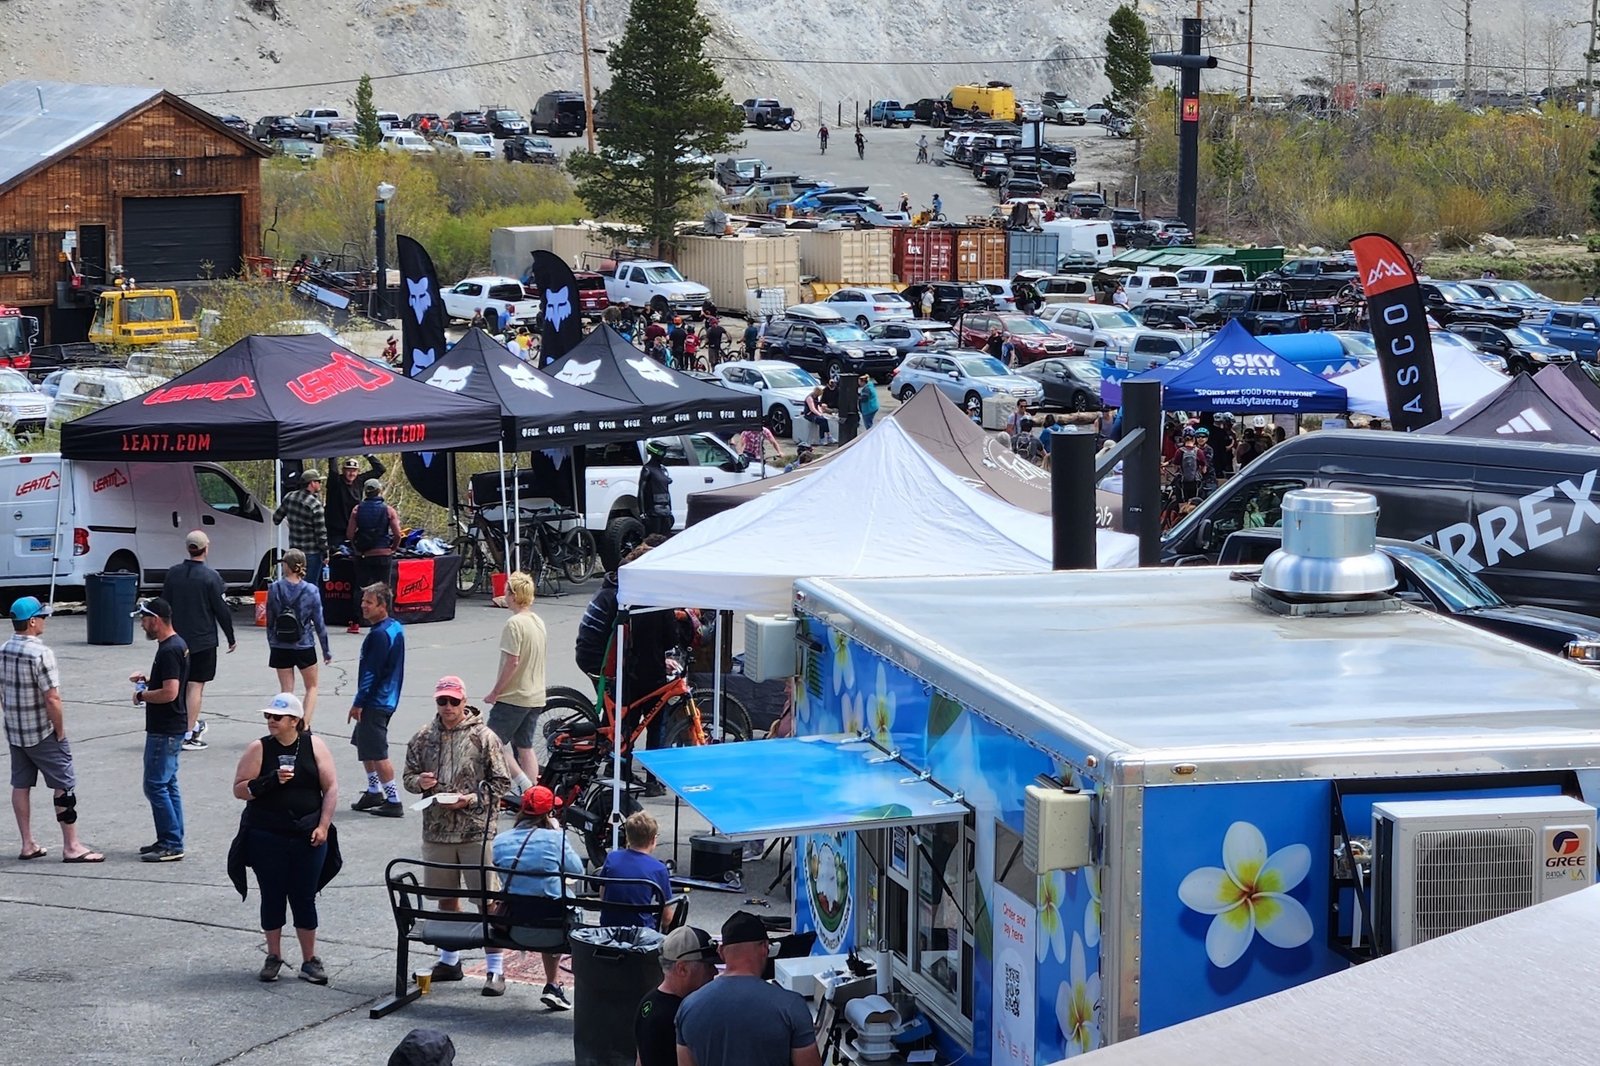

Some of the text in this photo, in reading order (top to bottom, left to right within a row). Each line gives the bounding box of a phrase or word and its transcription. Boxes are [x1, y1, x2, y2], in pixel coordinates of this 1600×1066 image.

[1231, 353, 1277, 367] SKY
[1383, 303, 1423, 432] ASCO
[1215, 367, 1281, 377] TAVERN
[1241, 388, 1262, 396] GOOD
[1211, 396, 1299, 408] www.skytavern.org
[122, 433, 211, 452] LEATT.COM
[363, 423, 426, 446] LEATT.COM
[1413, 469, 1600, 573] RREX
[1545, 855, 1586, 868] GREE
[1002, 902, 1026, 929] Order and
